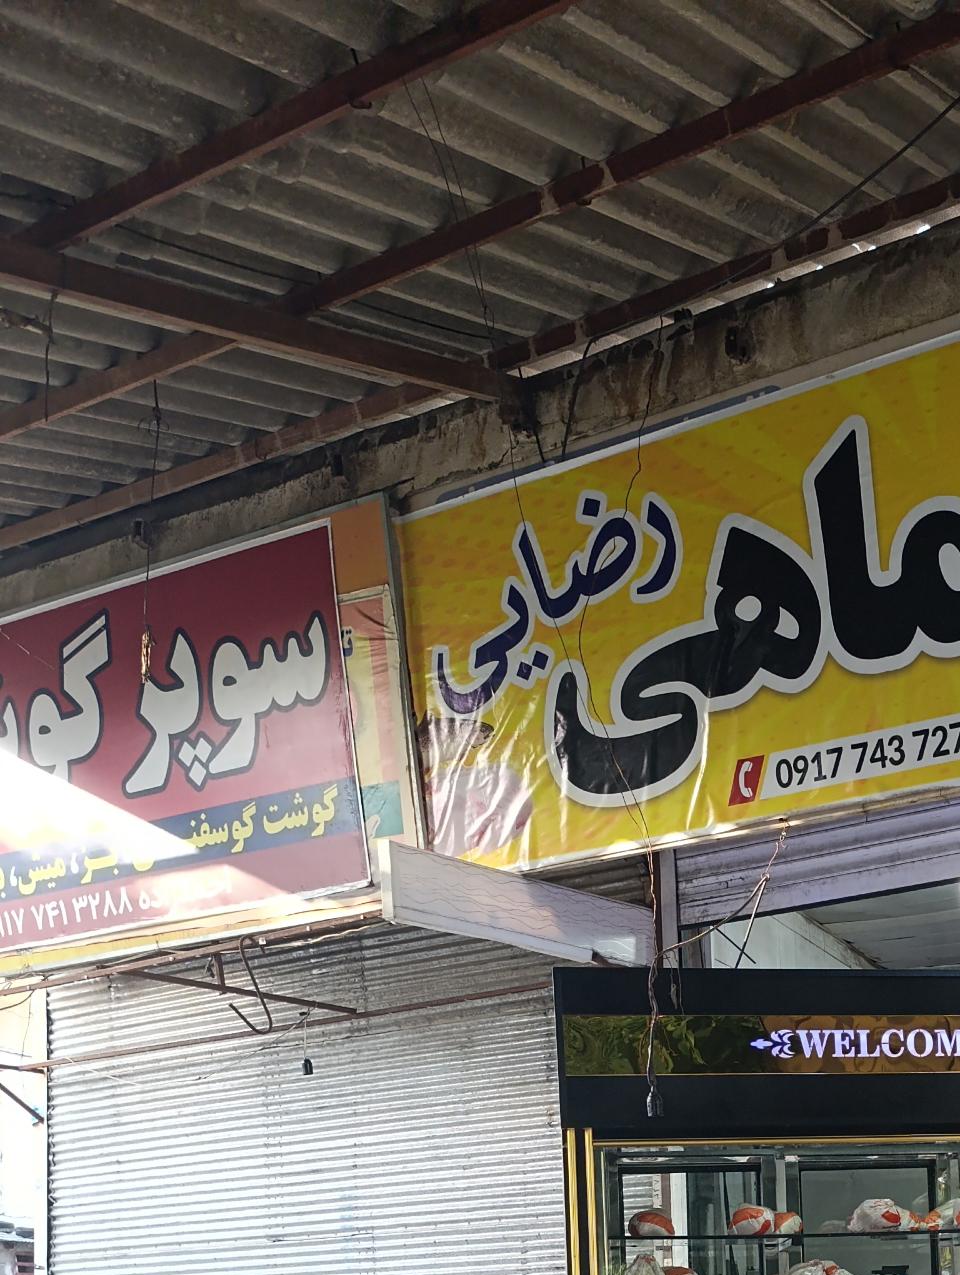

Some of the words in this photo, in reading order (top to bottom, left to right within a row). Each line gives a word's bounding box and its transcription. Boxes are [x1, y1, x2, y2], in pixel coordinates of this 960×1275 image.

[437, 496, 677, 715] رضایی
[125, 615, 326, 794] سوپر
[775, 746, 844, 789] 0917
[850, 734, 906, 774] 743
[262, 784, 338, 837] گوشت
